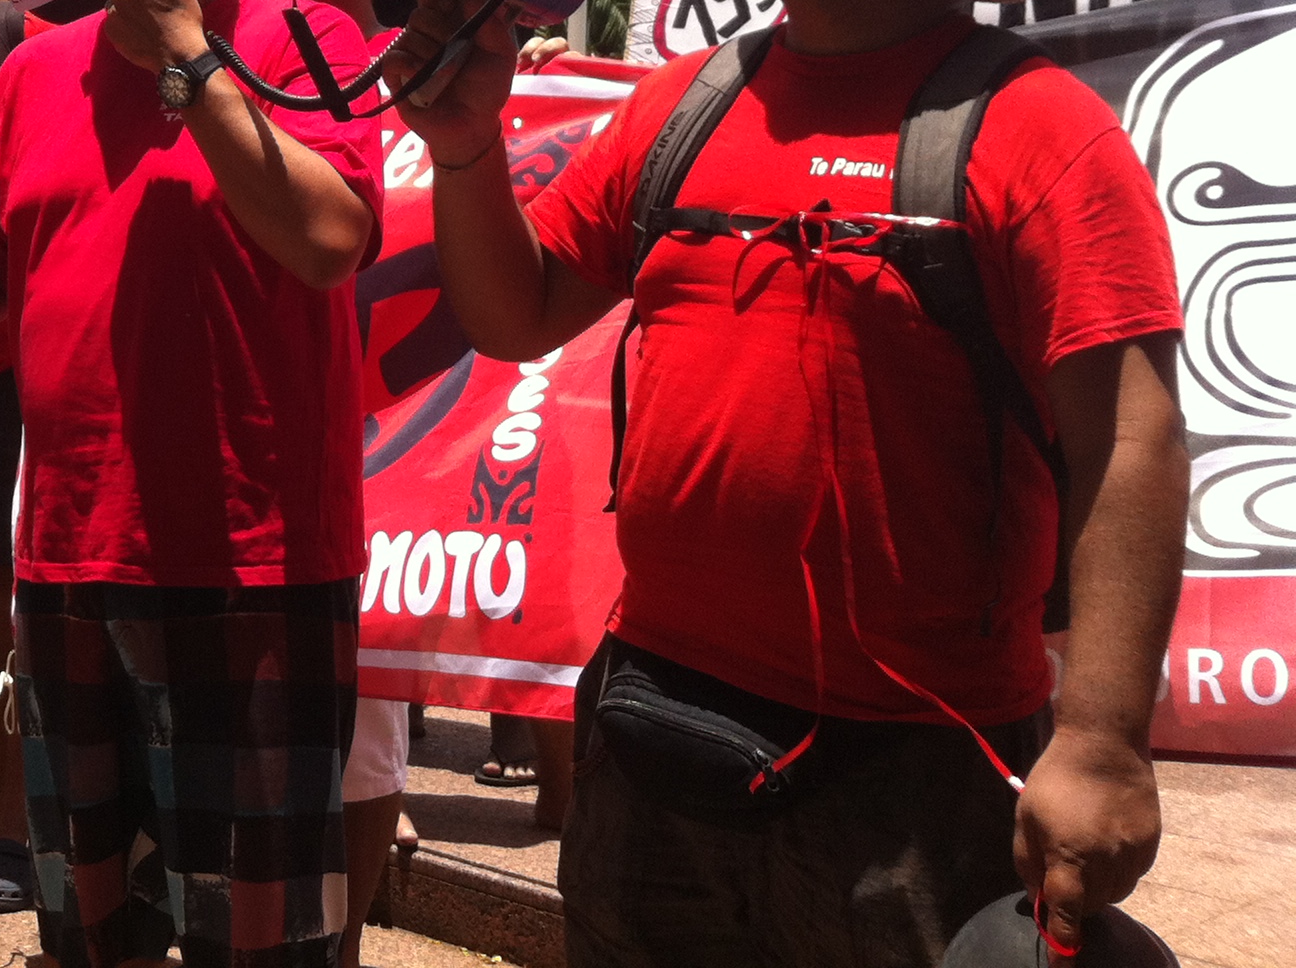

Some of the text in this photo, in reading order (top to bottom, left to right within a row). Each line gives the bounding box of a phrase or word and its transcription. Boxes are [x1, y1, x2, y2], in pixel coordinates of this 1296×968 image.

[809, 156, 886, 179] Te Parau
[360, 528, 527, 620] MOTU
